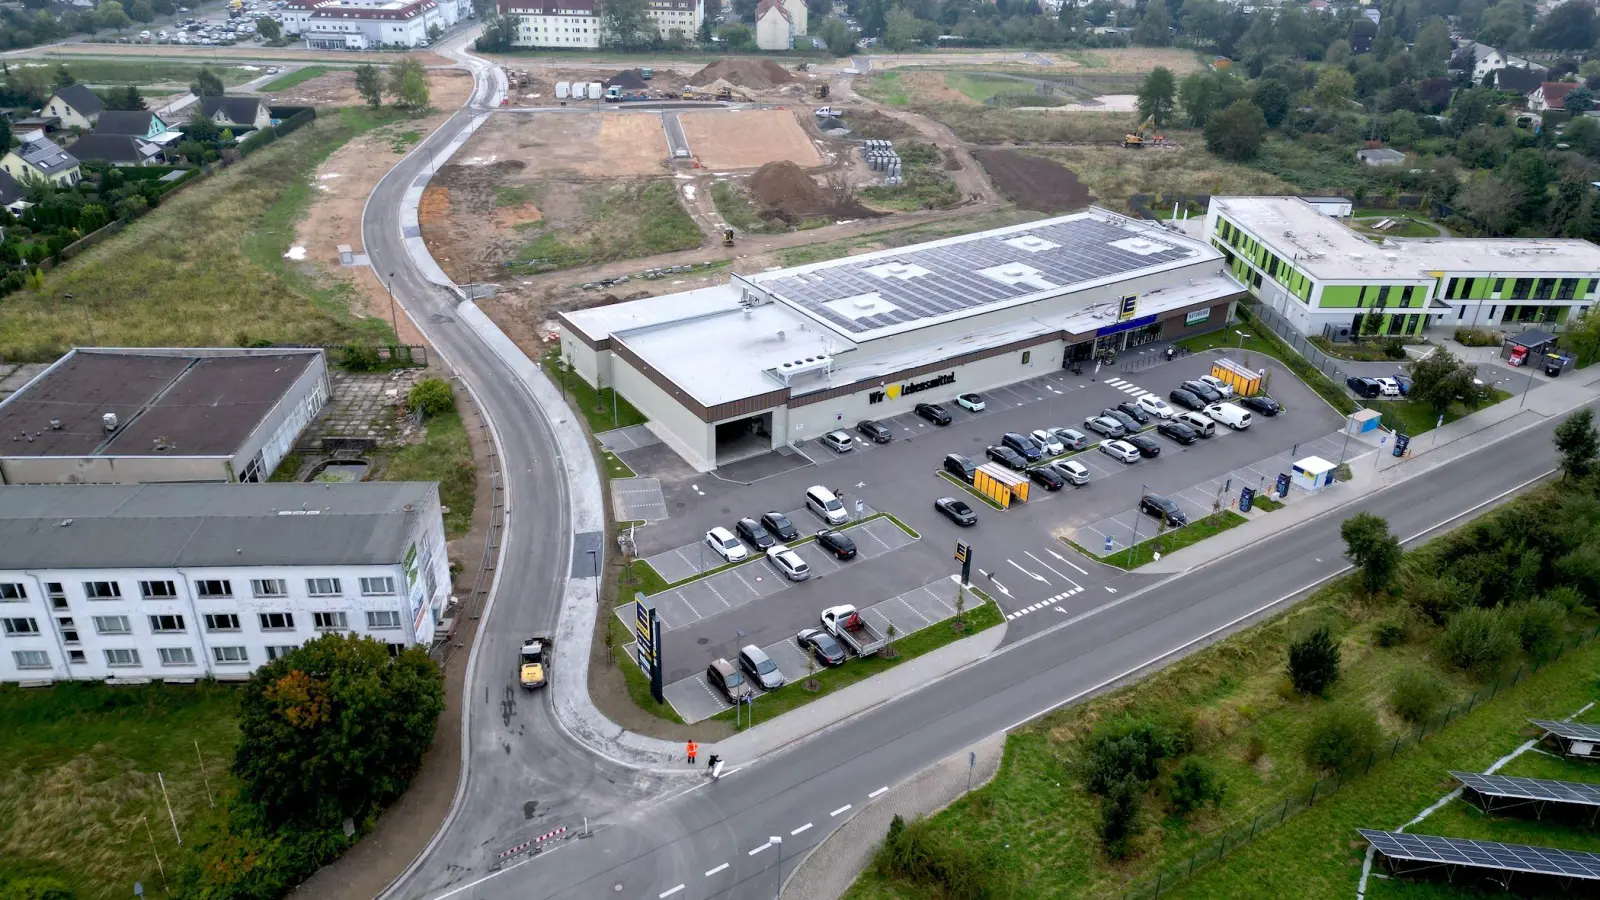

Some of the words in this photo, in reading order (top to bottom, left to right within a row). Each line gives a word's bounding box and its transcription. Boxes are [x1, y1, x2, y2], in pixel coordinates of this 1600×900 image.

[1123, 296, 1137, 313] E
[869, 390, 885, 405] Wir
[636, 600, 648, 632] E
